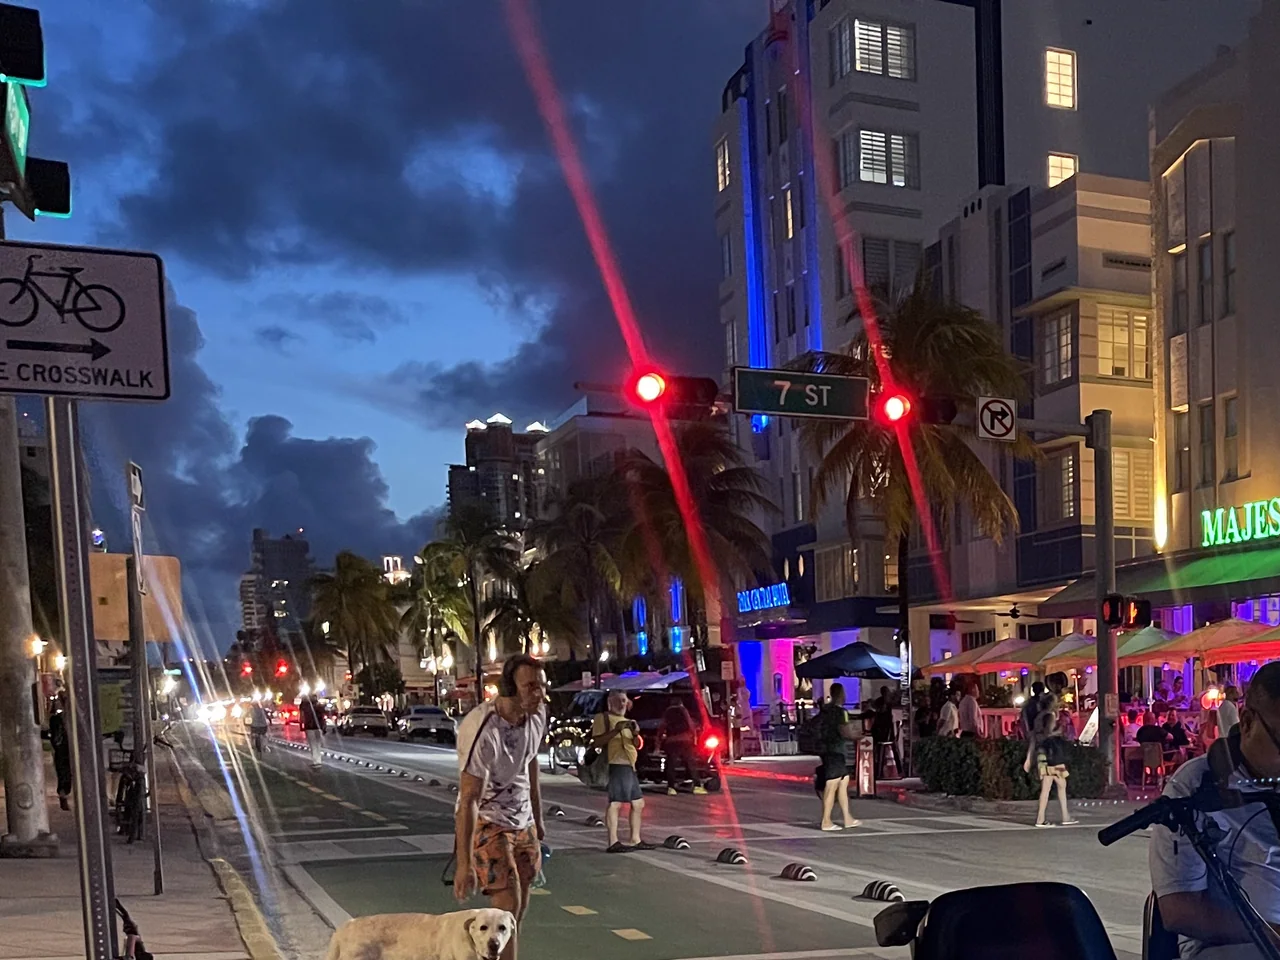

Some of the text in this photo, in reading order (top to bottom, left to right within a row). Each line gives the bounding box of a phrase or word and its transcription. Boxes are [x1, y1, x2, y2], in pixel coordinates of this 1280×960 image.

[17, 363, 153, 388] CROSSWALK
[774, 380, 831, 406] 7 ST
